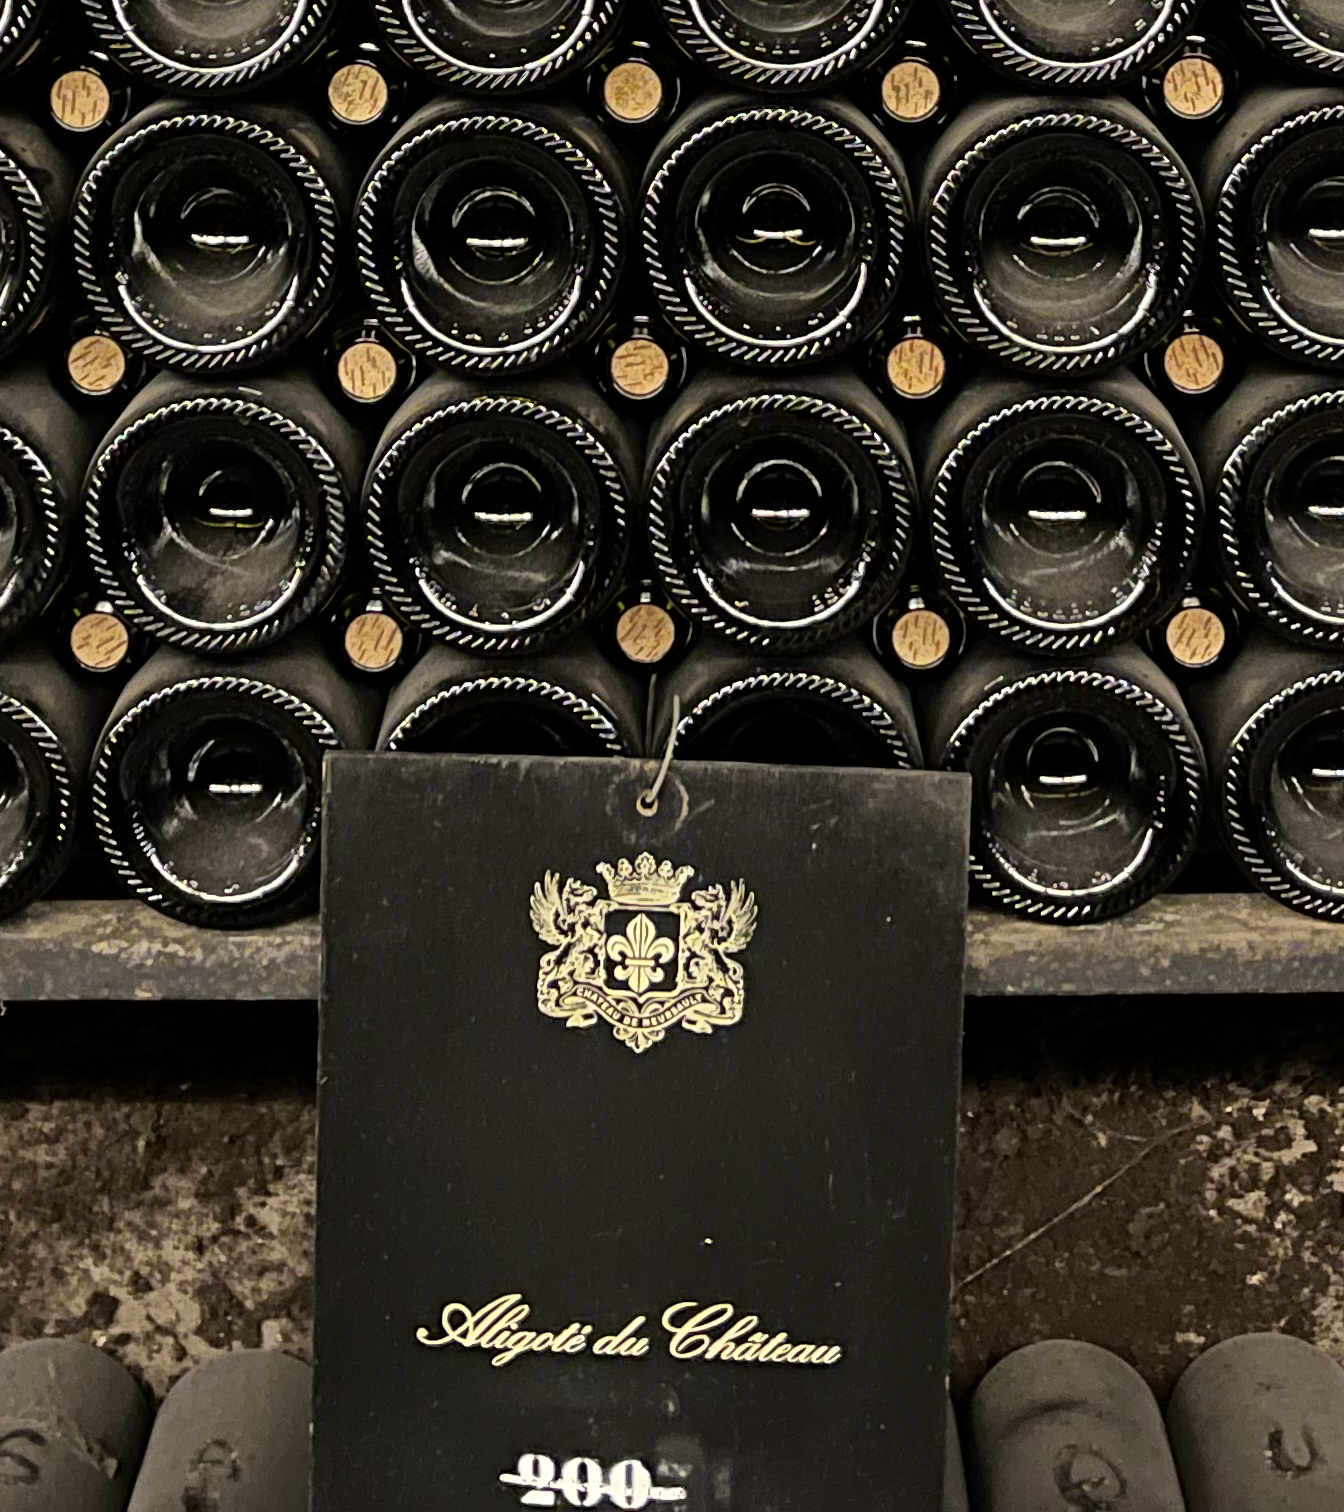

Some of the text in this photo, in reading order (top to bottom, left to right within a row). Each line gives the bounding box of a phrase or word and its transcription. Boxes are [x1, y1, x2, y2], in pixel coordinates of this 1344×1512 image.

[415, 1293, 842, 1367] Aligoté du Château
